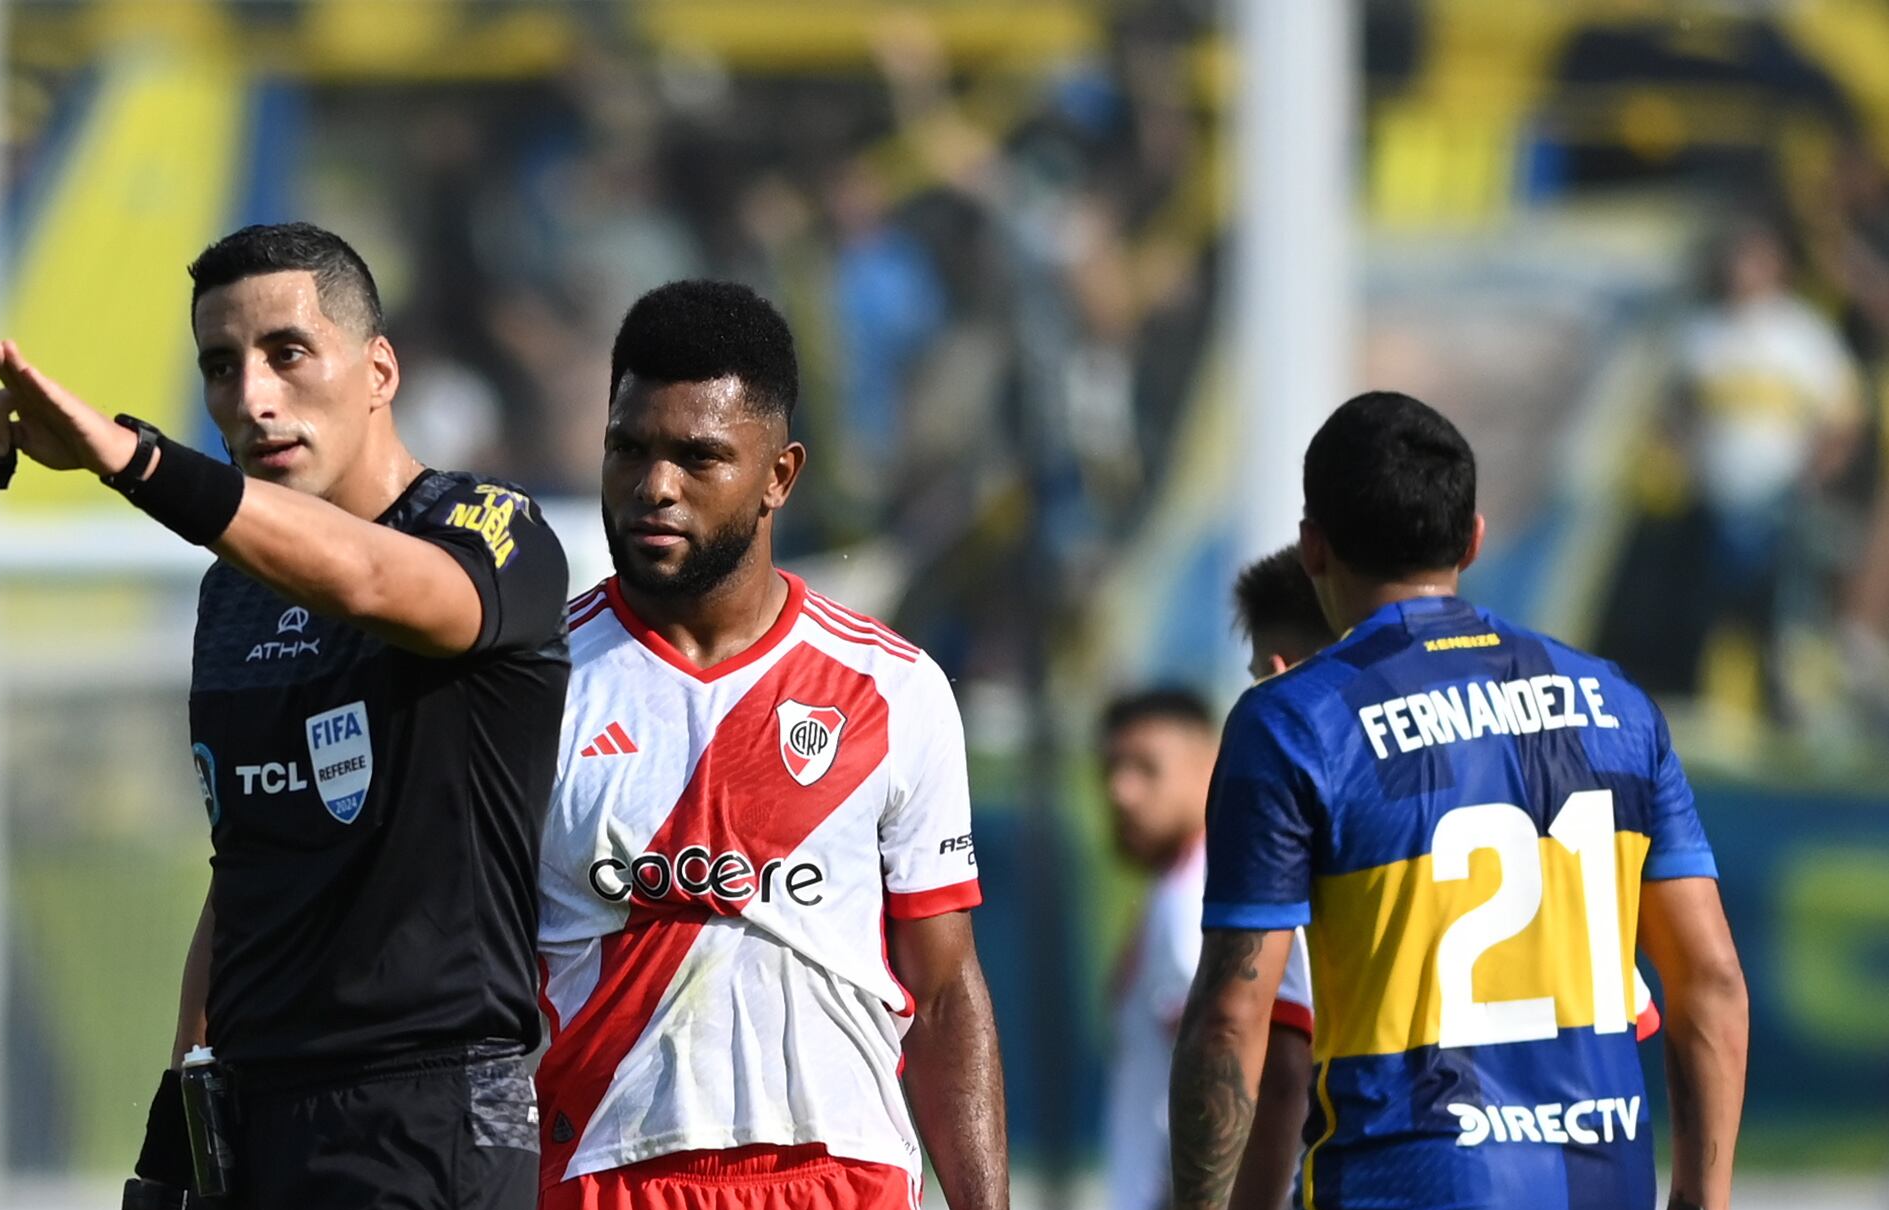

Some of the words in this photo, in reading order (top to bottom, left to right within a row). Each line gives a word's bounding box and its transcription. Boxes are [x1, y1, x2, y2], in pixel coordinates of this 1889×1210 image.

[312, 711, 363, 750] FIFA
[1359, 675, 1589, 760] FERNANDEZ
[235, 762, 308, 795] TCL
[318, 755, 367, 782] REFEREE
[336, 796, 359, 814] 2024
[1431, 789, 1629, 1049] 21
[1446, 1095, 1641, 1147] DIRECTV
